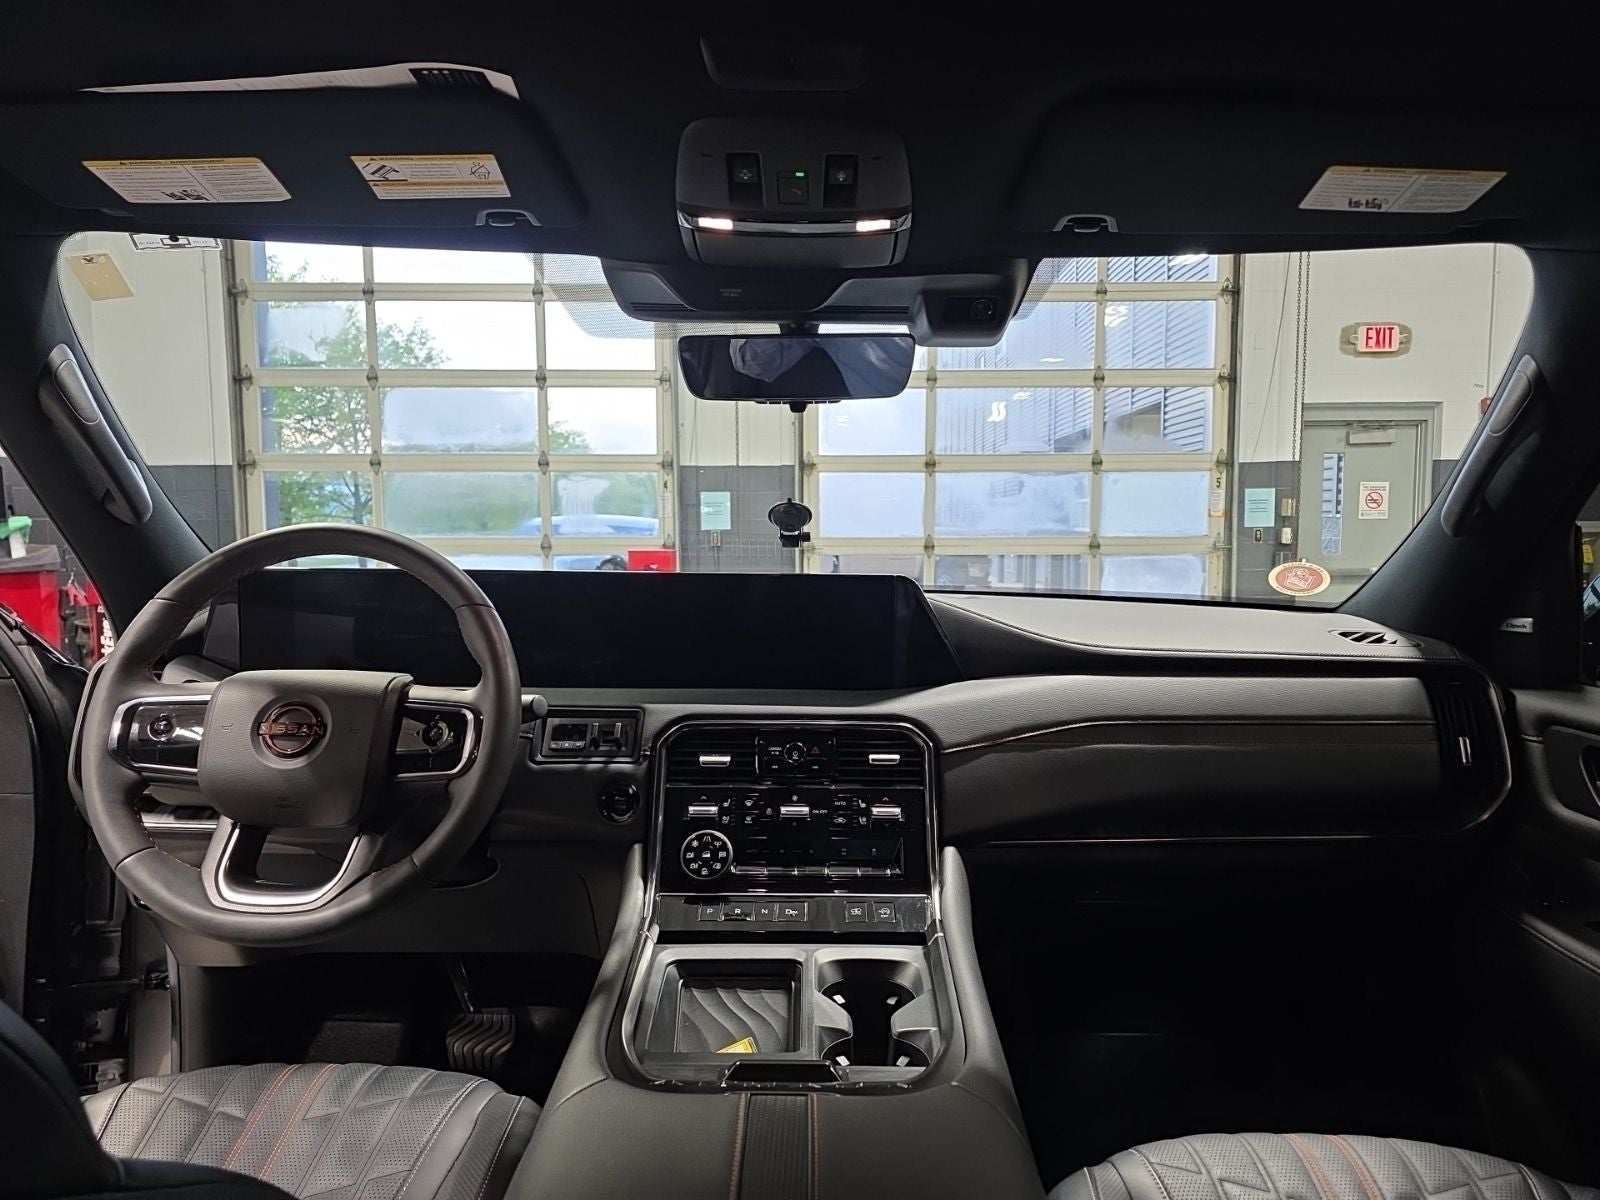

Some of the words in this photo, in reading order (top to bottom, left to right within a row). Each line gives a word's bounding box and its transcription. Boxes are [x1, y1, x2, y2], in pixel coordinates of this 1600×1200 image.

[1365, 326, 1395, 349] EXIT
[1215, 477, 1222, 489] 5
[259, 721, 325, 736] NISSAN
